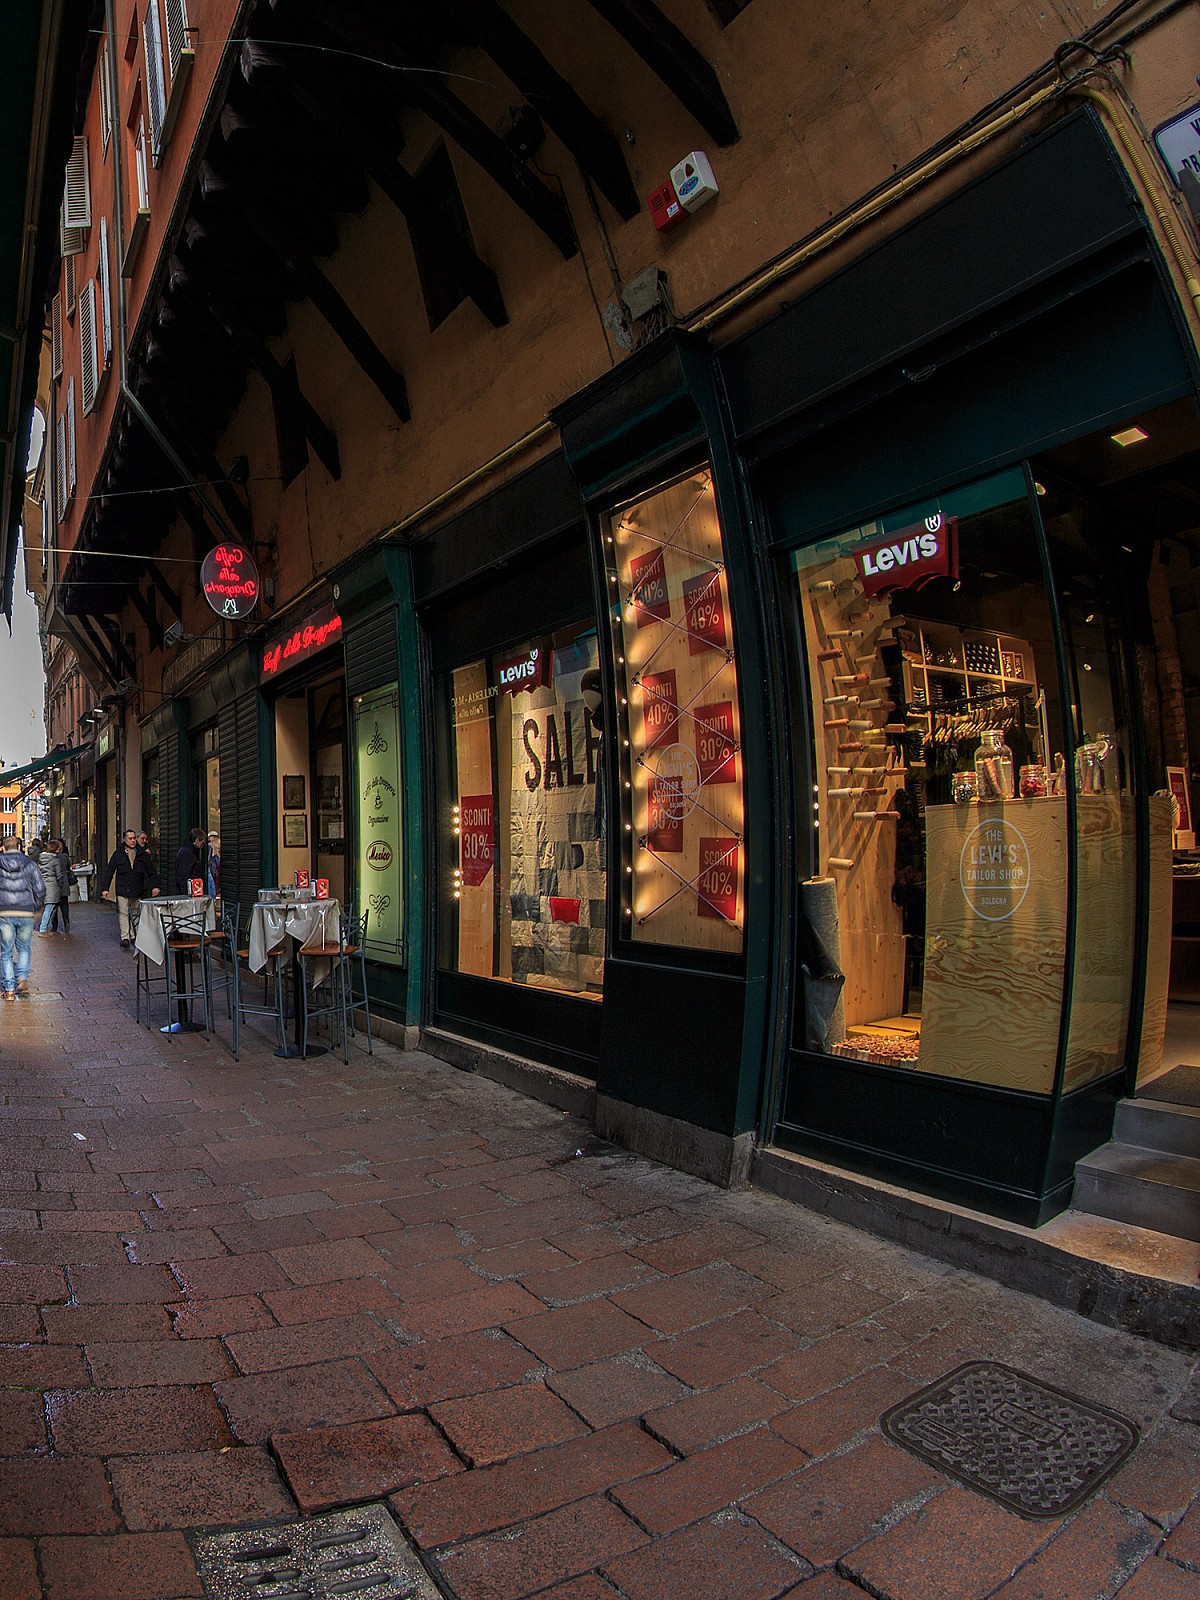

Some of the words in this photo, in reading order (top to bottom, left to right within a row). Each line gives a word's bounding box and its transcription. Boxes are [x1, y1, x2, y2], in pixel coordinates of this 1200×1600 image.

[635, 561, 661, 582] SCONTI
[637, 577, 664, 607] 30%
[688, 583, 717, 605] SCONTI
[690, 602, 720, 631] 40%
[647, 682, 673, 701] SCONTI
[647, 703, 674, 727] 40%
[699, 715, 729, 734] SCONTI
[699, 736, 730, 762] 30%
[463, 807, 491, 826] SCONTI
[464, 832, 490, 860] 30%
[985, 829, 1003, 842] THE
[704, 849, 734, 867] SCONTI
[970, 844, 1018, 865] LEVI'S
[702, 870, 733, 896] 40%
[966, 869, 997, 881] TAILOR
[999, 869, 1024, 880] SHOP
[981, 897, 1007, 906] BOLOGNA
